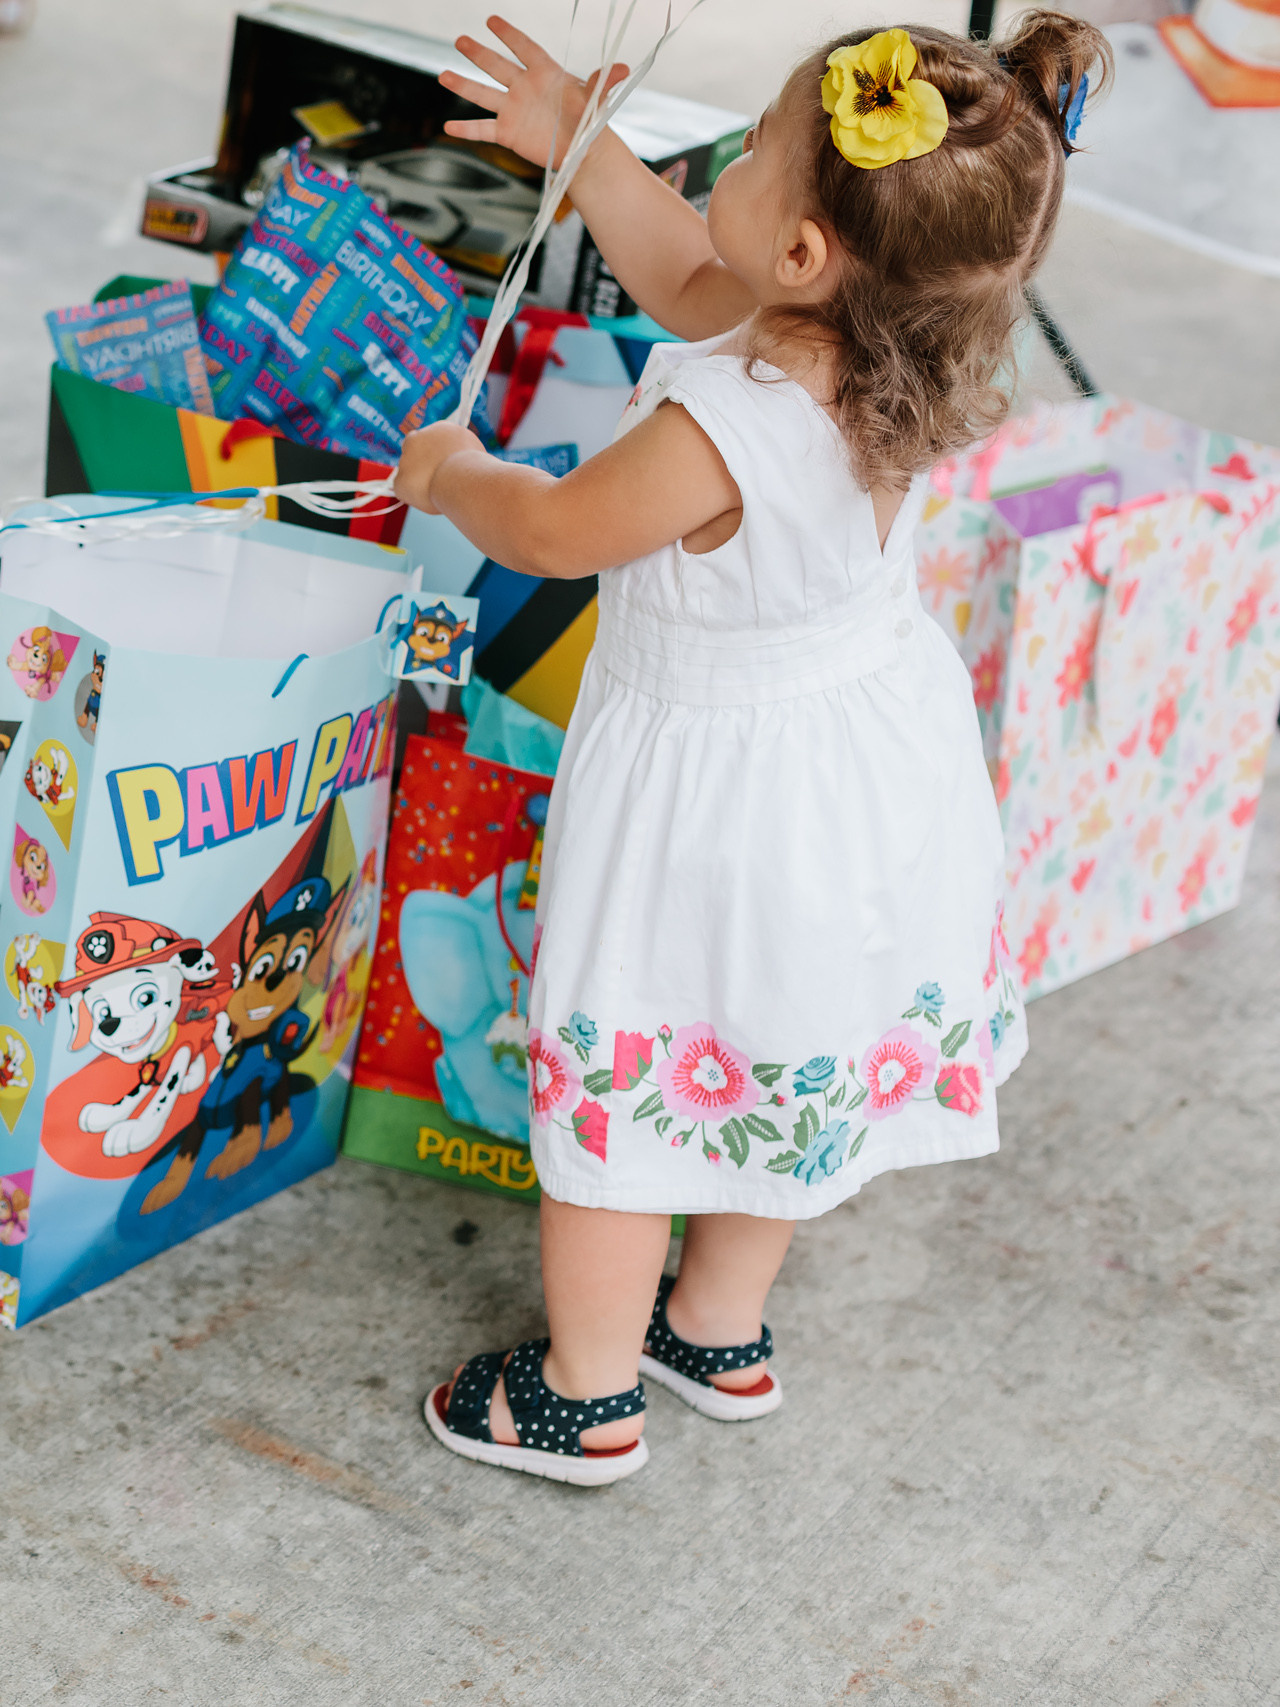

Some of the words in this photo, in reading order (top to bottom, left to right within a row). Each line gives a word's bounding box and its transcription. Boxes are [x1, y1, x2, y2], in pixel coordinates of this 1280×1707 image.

[335, 239, 433, 328] BIRTHDAY
[106, 739, 299, 887] PAW
[416, 1126, 537, 1190] PARTY
